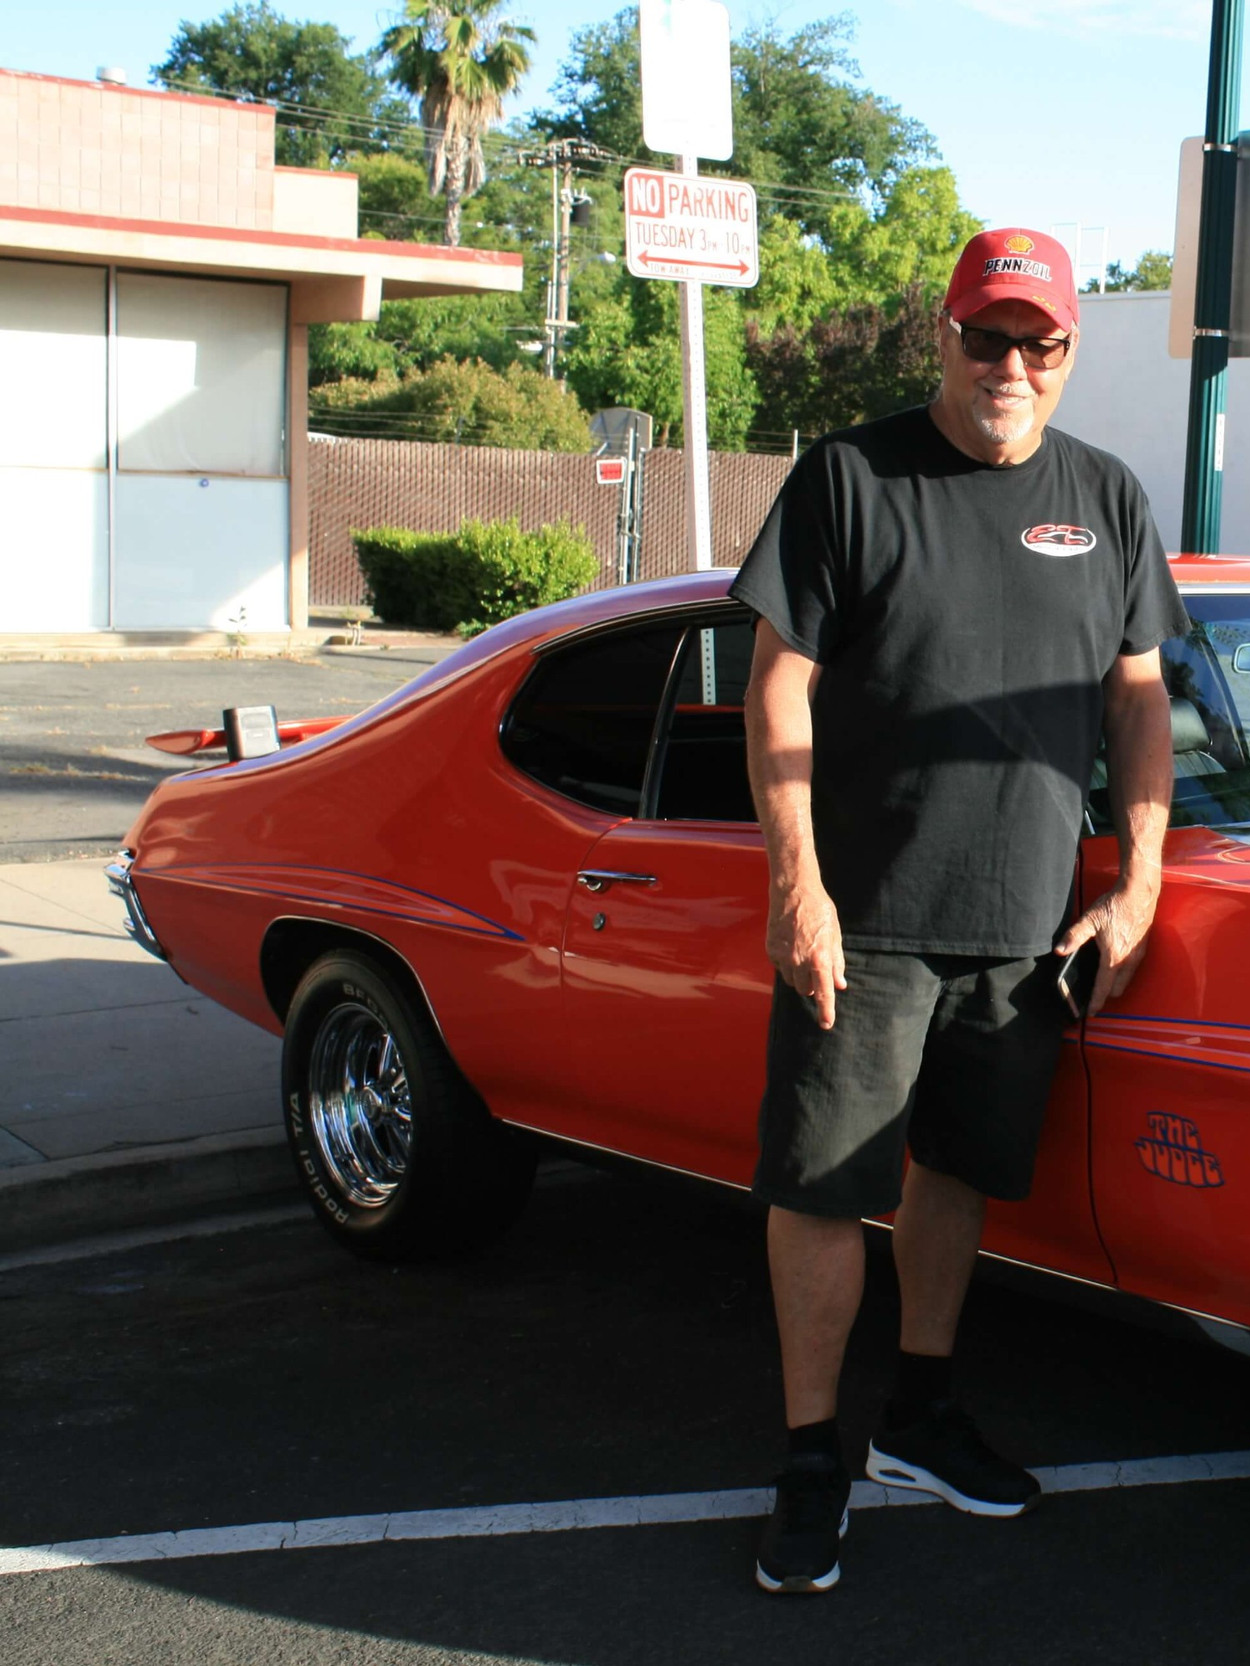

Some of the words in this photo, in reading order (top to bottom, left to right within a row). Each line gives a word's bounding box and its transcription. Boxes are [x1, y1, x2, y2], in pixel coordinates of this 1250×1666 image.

[631, 176, 661, 213] NO
[668, 184, 749, 222] PARKING
[635, 221, 695, 249] TUESDAY
[650, 263, 666, 273] TOW
[669, 265, 690, 275] AWAY
[983, 257, 1052, 282] PENNZOIL
[1146, 1110, 1201, 1152] THE
[299, 1150, 349, 1224] Radial
